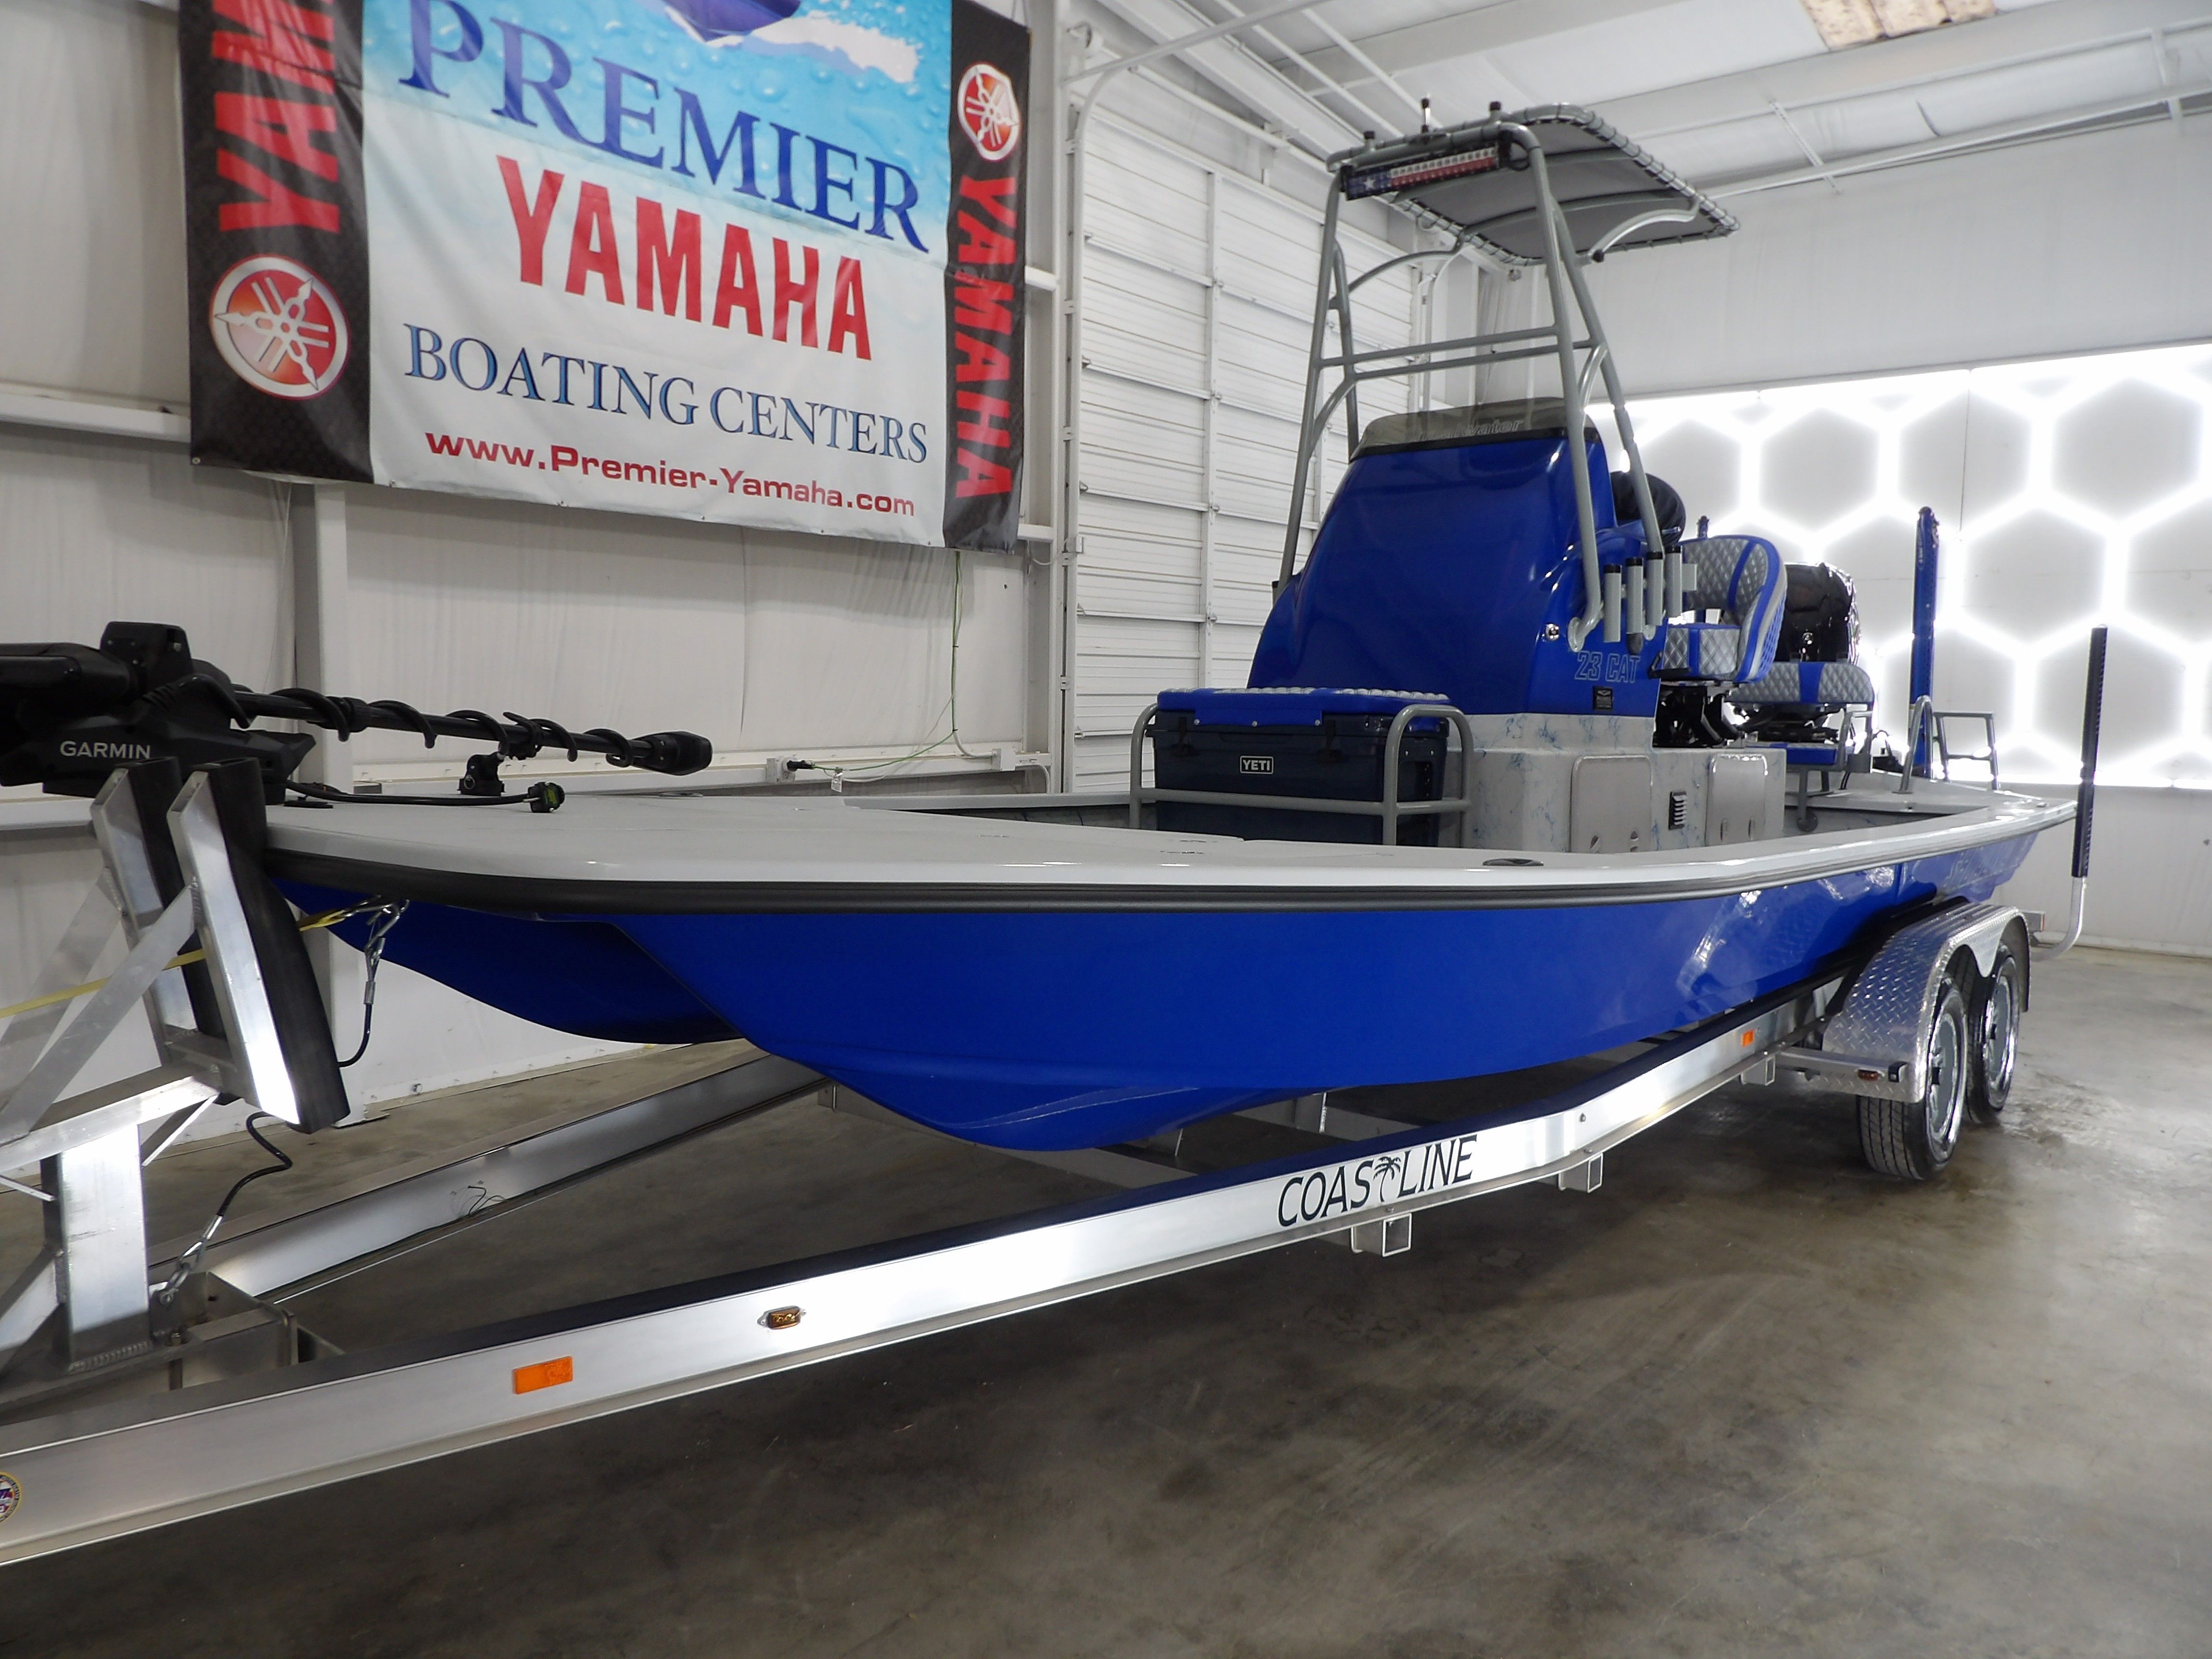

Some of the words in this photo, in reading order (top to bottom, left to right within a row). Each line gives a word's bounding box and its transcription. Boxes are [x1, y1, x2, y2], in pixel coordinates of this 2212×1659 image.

[399, 0, 929, 253] PREMIER
[496, 155, 872, 361] YAMAHA
[954, 174, 1017, 498] YAMAHA
[403, 323, 699, 426] BOATING
[710, 385, 927, 464] CENTERS
[425, 432, 915, 517] www.Premier-Yamaha.com
[1575, 650, 1603, 681] 23
[1605, 653, 1641, 683] CAT
[60, 740, 151, 759] GARMIN
[1242, 759, 1271, 771] YETI
